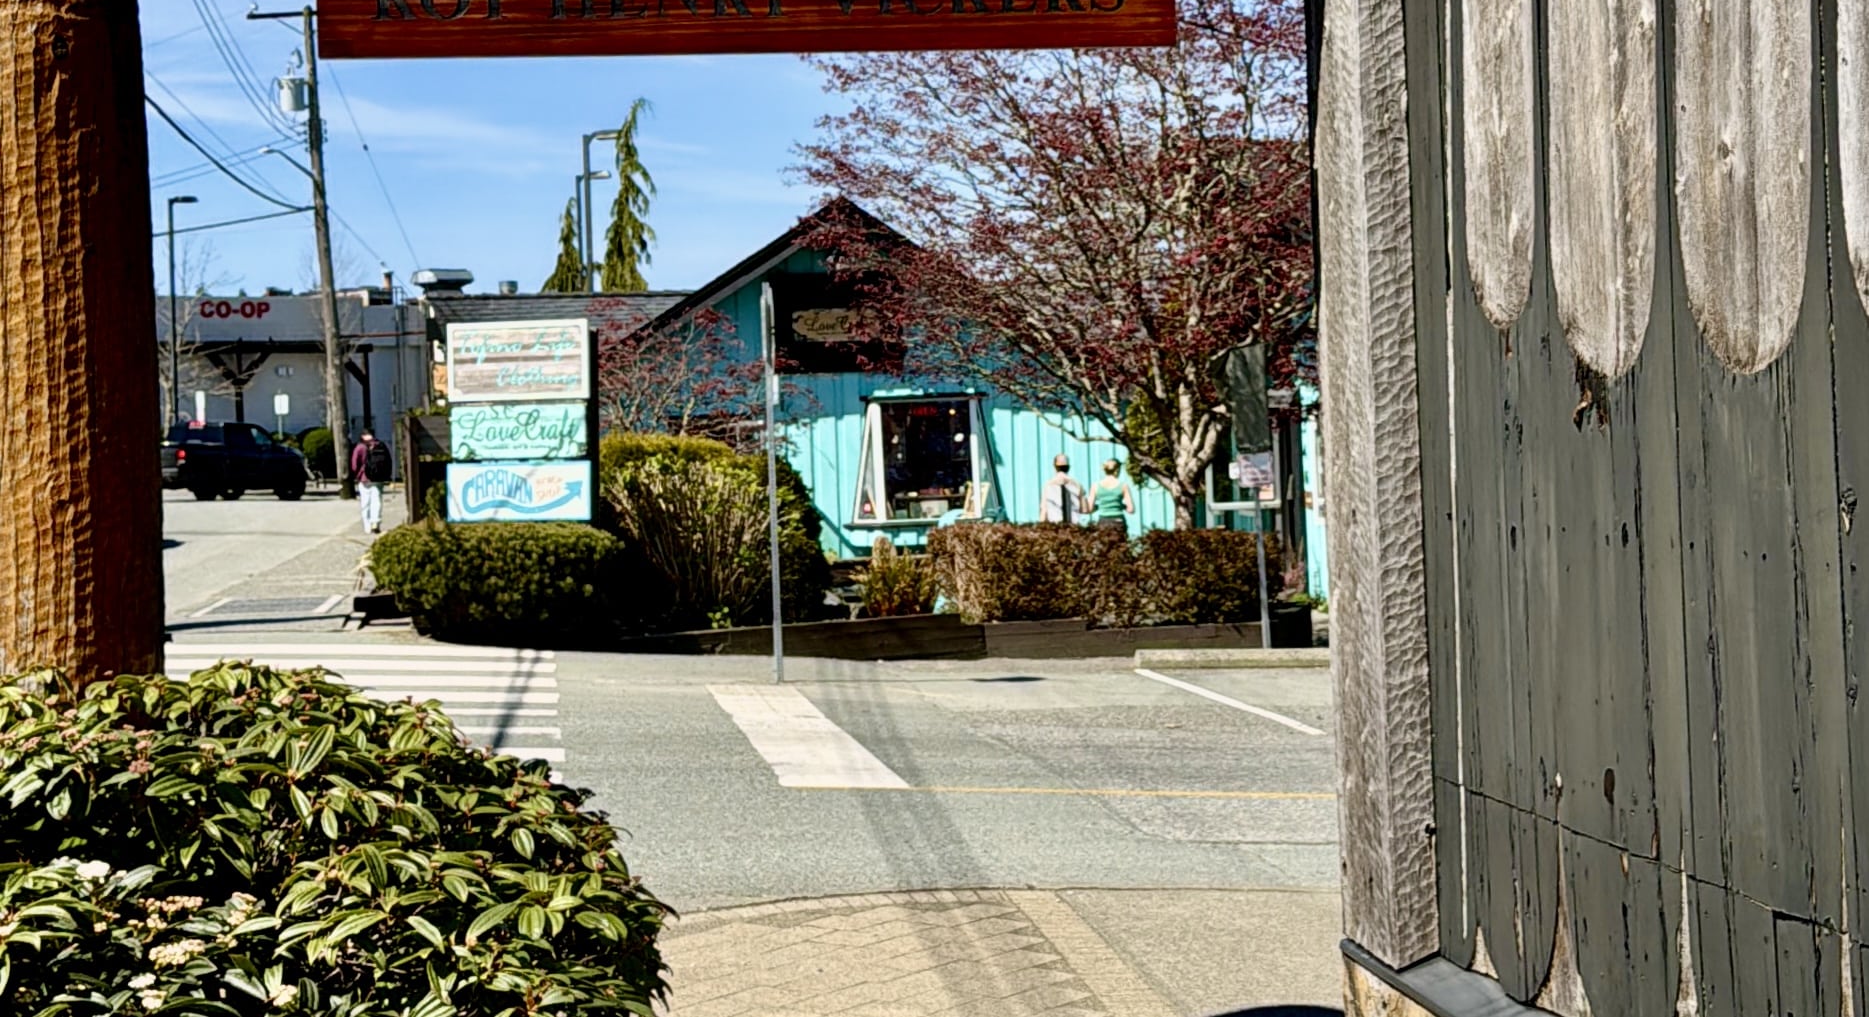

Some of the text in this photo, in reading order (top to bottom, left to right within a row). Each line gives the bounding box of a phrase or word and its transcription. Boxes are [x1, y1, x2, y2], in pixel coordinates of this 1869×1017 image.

[200, 300, 271, 319] CO-OP
[496, 366, 581, 392] Clothing
[462, 469, 533, 509] CARAVAN
